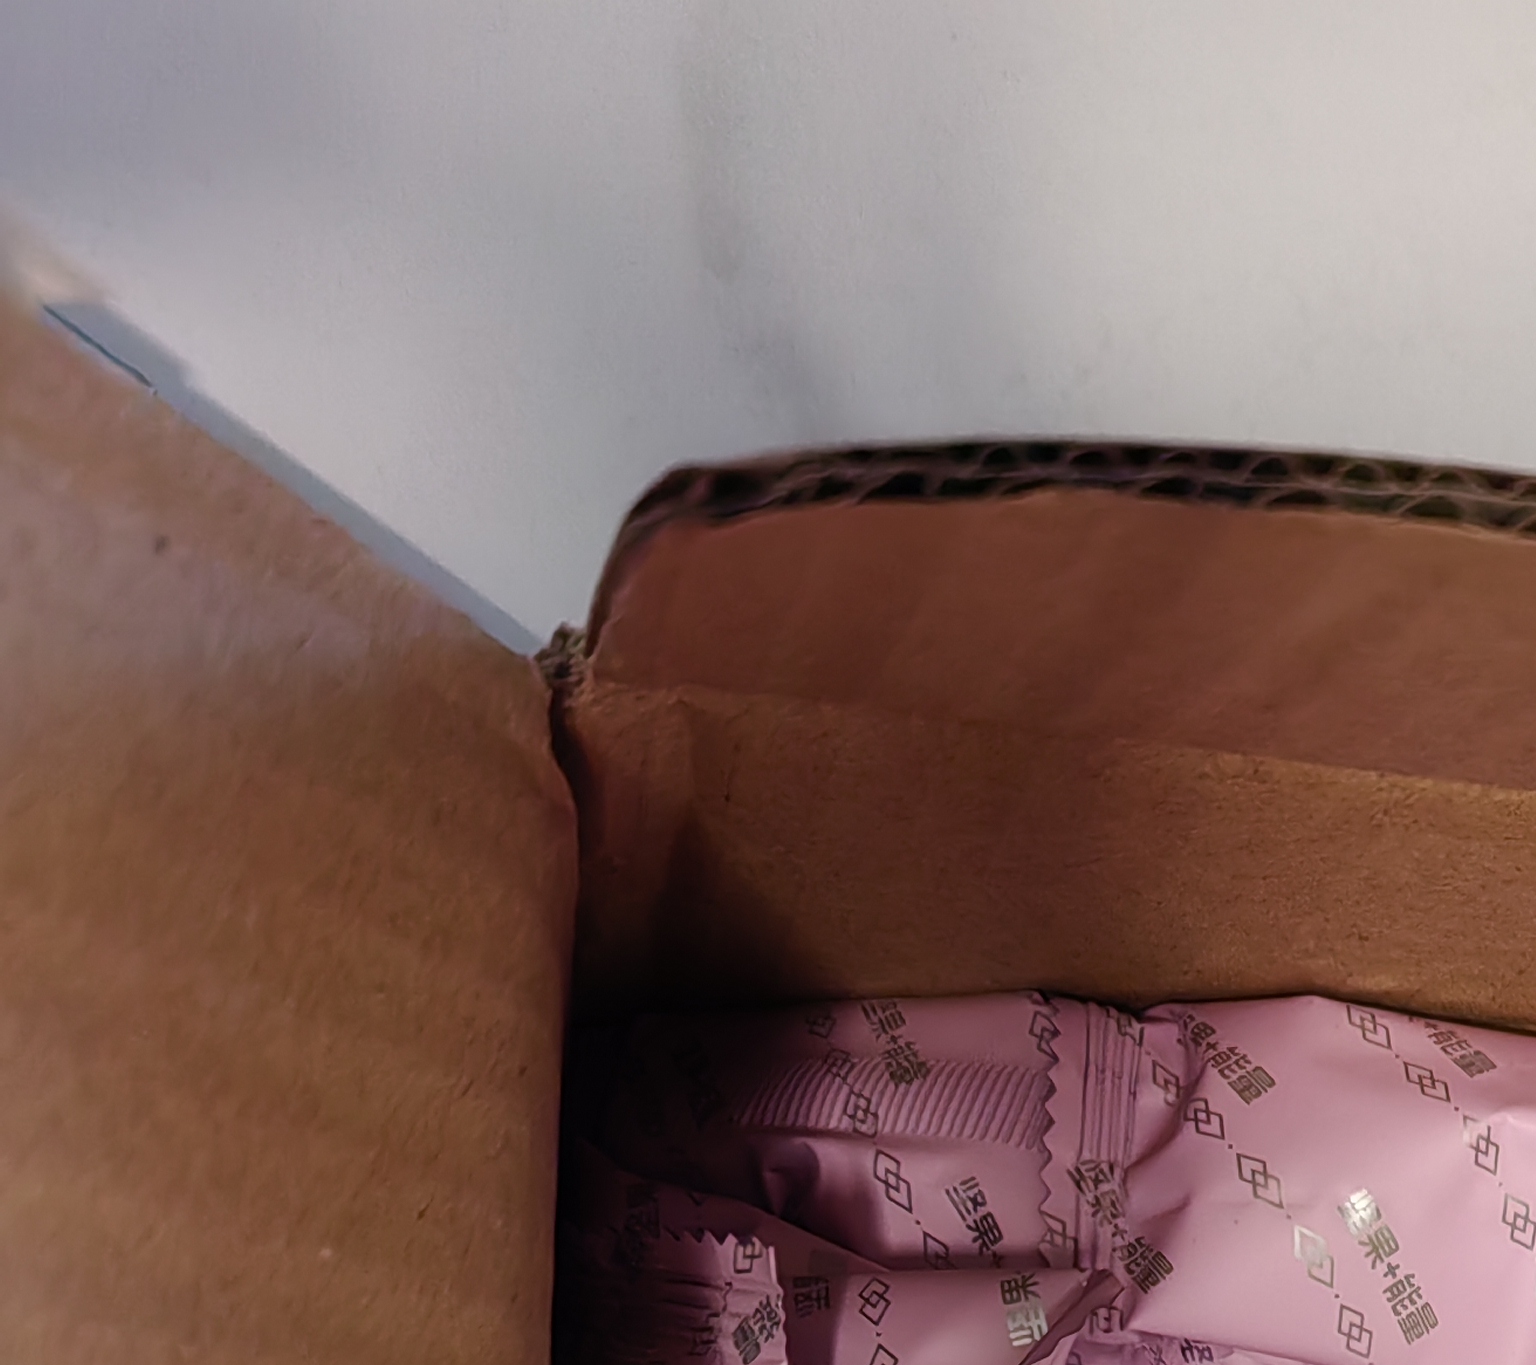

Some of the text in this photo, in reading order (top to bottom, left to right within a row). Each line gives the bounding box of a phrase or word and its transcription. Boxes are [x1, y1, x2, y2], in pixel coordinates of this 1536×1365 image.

[1408, 1015, 1498, 1080] +能量
[1337, 1187, 1440, 1345] 坚果+能量
